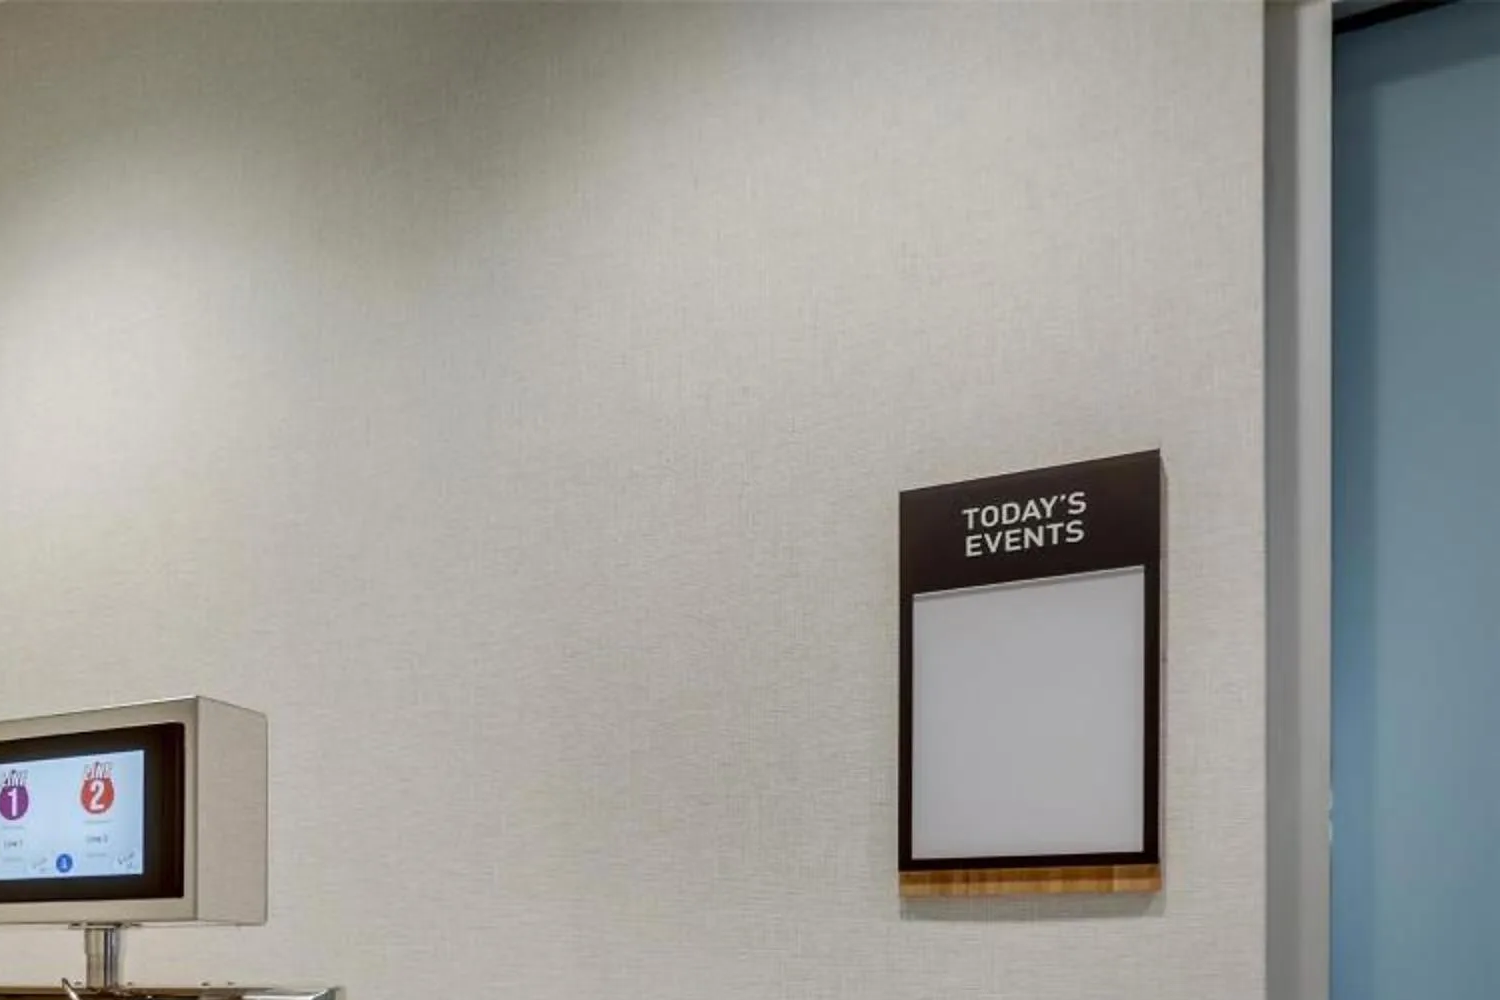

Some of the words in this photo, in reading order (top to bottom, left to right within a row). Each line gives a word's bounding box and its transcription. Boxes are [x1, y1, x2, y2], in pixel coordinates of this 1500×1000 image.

[961, 491, 1087, 530] TODAY'S
[965, 519, 1085, 557] EVENTS
[7, 787, 18, 817] 1
[90, 780, 105, 811] 2
